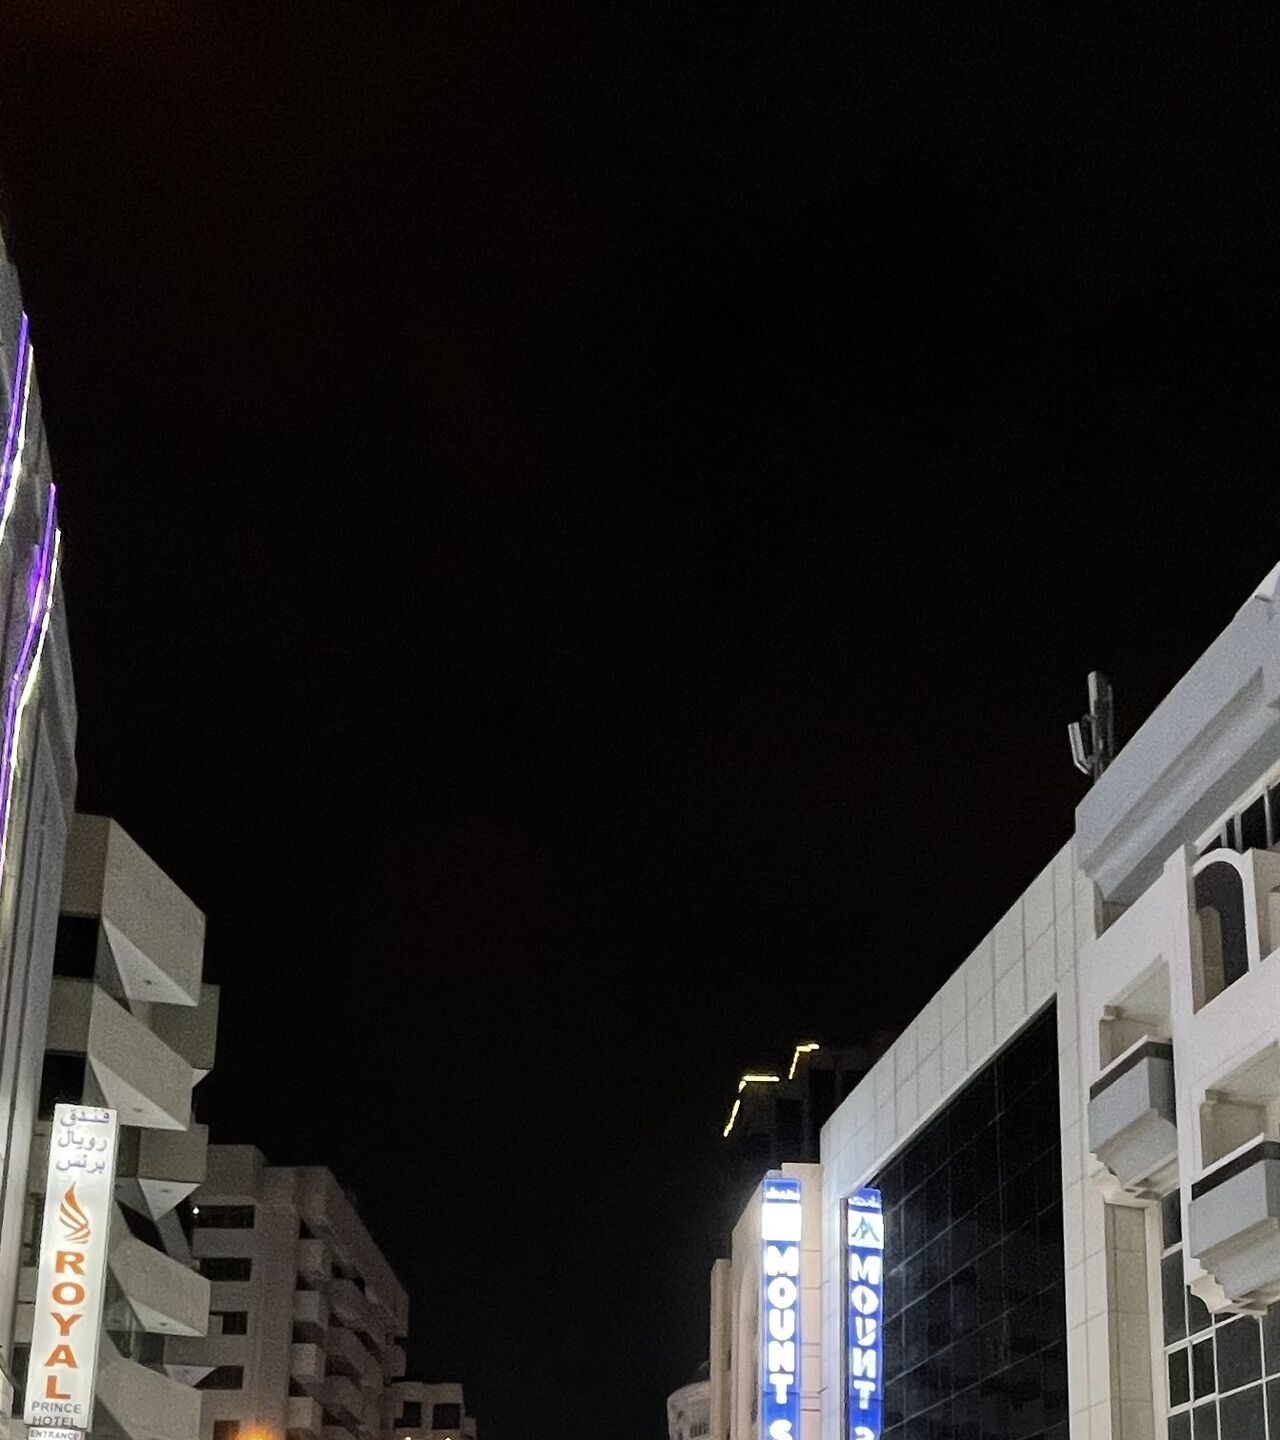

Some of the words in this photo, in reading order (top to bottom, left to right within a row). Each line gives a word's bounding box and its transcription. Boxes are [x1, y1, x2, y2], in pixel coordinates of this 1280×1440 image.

[58, 1130, 108, 1152] رويال
[44, 1250, 87, 1400] ROYAL
[766, 1245, 799, 1405] MOUNT
[31, 1401, 83, 1414] PRINCE
[32, 1415, 78, 1428] HOTEL
[29, 1429, 80, 1440] ENTRANCE
